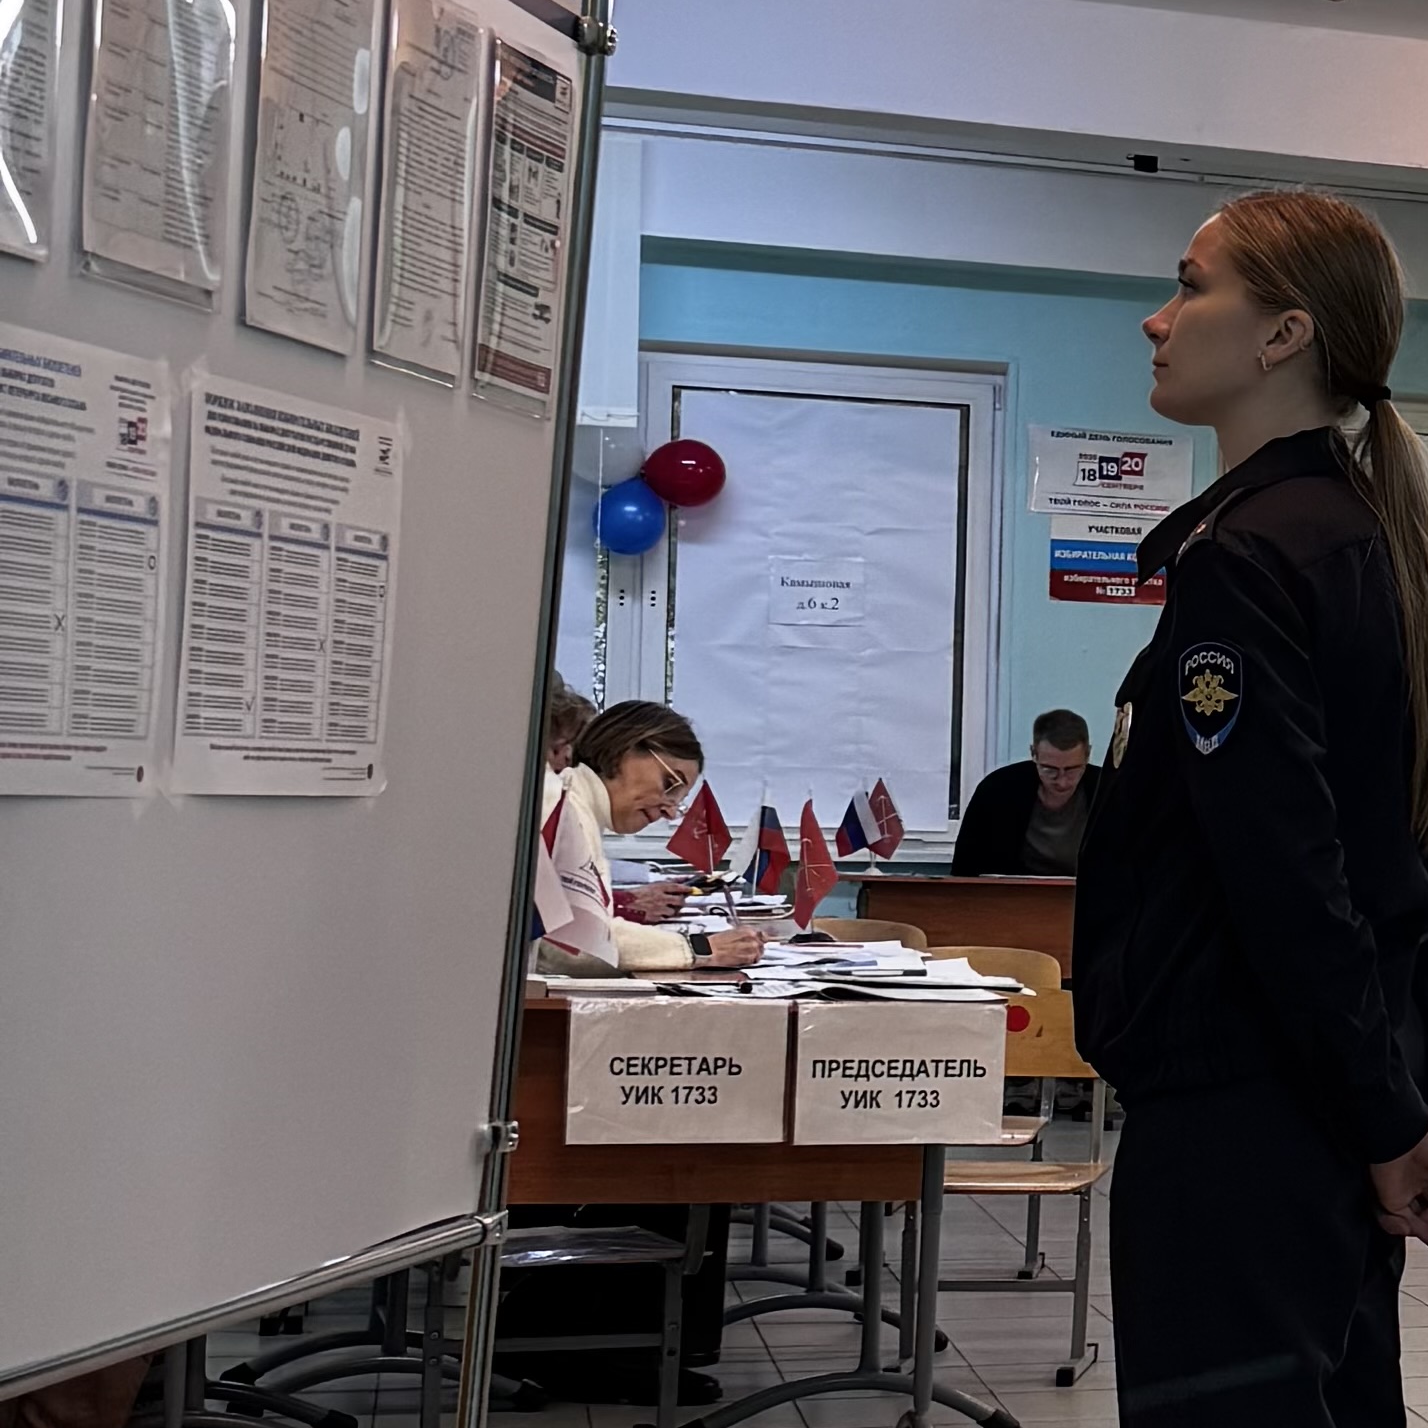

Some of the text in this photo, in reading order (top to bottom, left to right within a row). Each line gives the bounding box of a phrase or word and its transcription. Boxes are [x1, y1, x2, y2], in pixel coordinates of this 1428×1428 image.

[1080, 458, 1143, 481] 18 19 20
[1184, 651, 1235, 675] РОССИЯ
[1195, 733, 1220, 755] МВД
[609, 1056, 743, 1077] СЕКРЕТАРЬ
[811, 1058, 988, 1082] ПРЕДСЕДАТЕЛЬ
[620, 1085, 719, 1106] УИК 1733
[839, 1089, 941, 1110] УИК 1733
